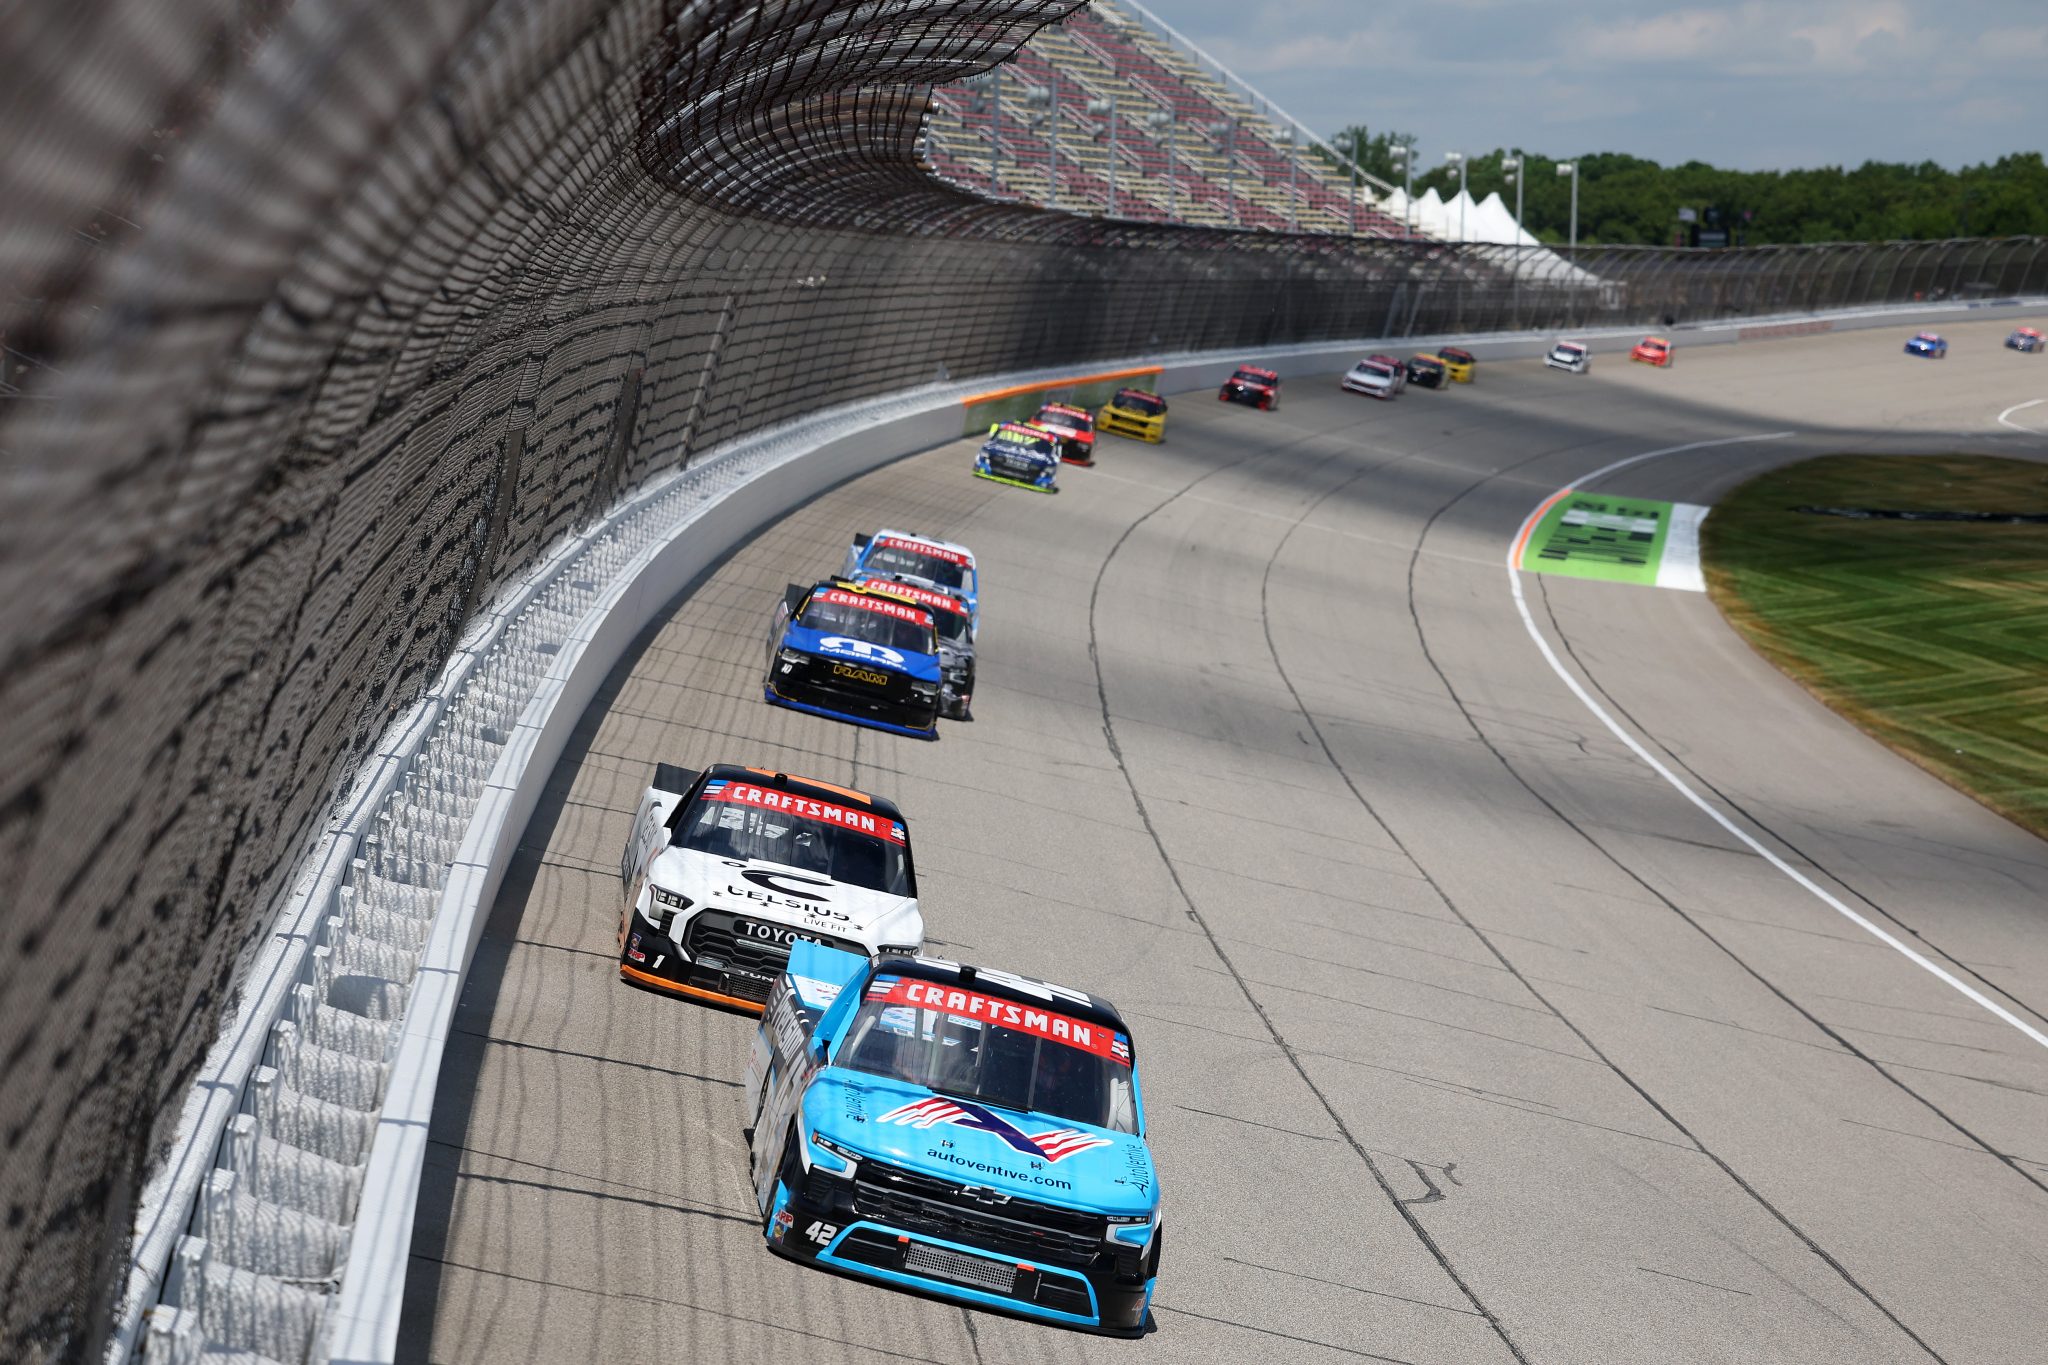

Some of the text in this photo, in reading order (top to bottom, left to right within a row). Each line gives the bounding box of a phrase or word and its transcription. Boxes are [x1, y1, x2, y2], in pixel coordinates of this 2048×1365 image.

[889, 539, 959, 562] CRAFTSMAN
[830, 592, 916, 620] CRAFTSMAN
[870, 579, 952, 609] CRAFTSMAN
[834, 665, 888, 685] RAM
[733, 786, 876, 832] CRAFTSMAN
[727, 885, 850, 921] CELSIUS
[804, 918, 847, 933] LIVE FIT
[652, 954, 666, 969] 1
[738, 970, 774, 982] TUN
[906, 983, 1091, 1047] CRAFTSMAN
[927, 1148, 1072, 1190] autoventive.com
[805, 1220, 838, 1246] 42
